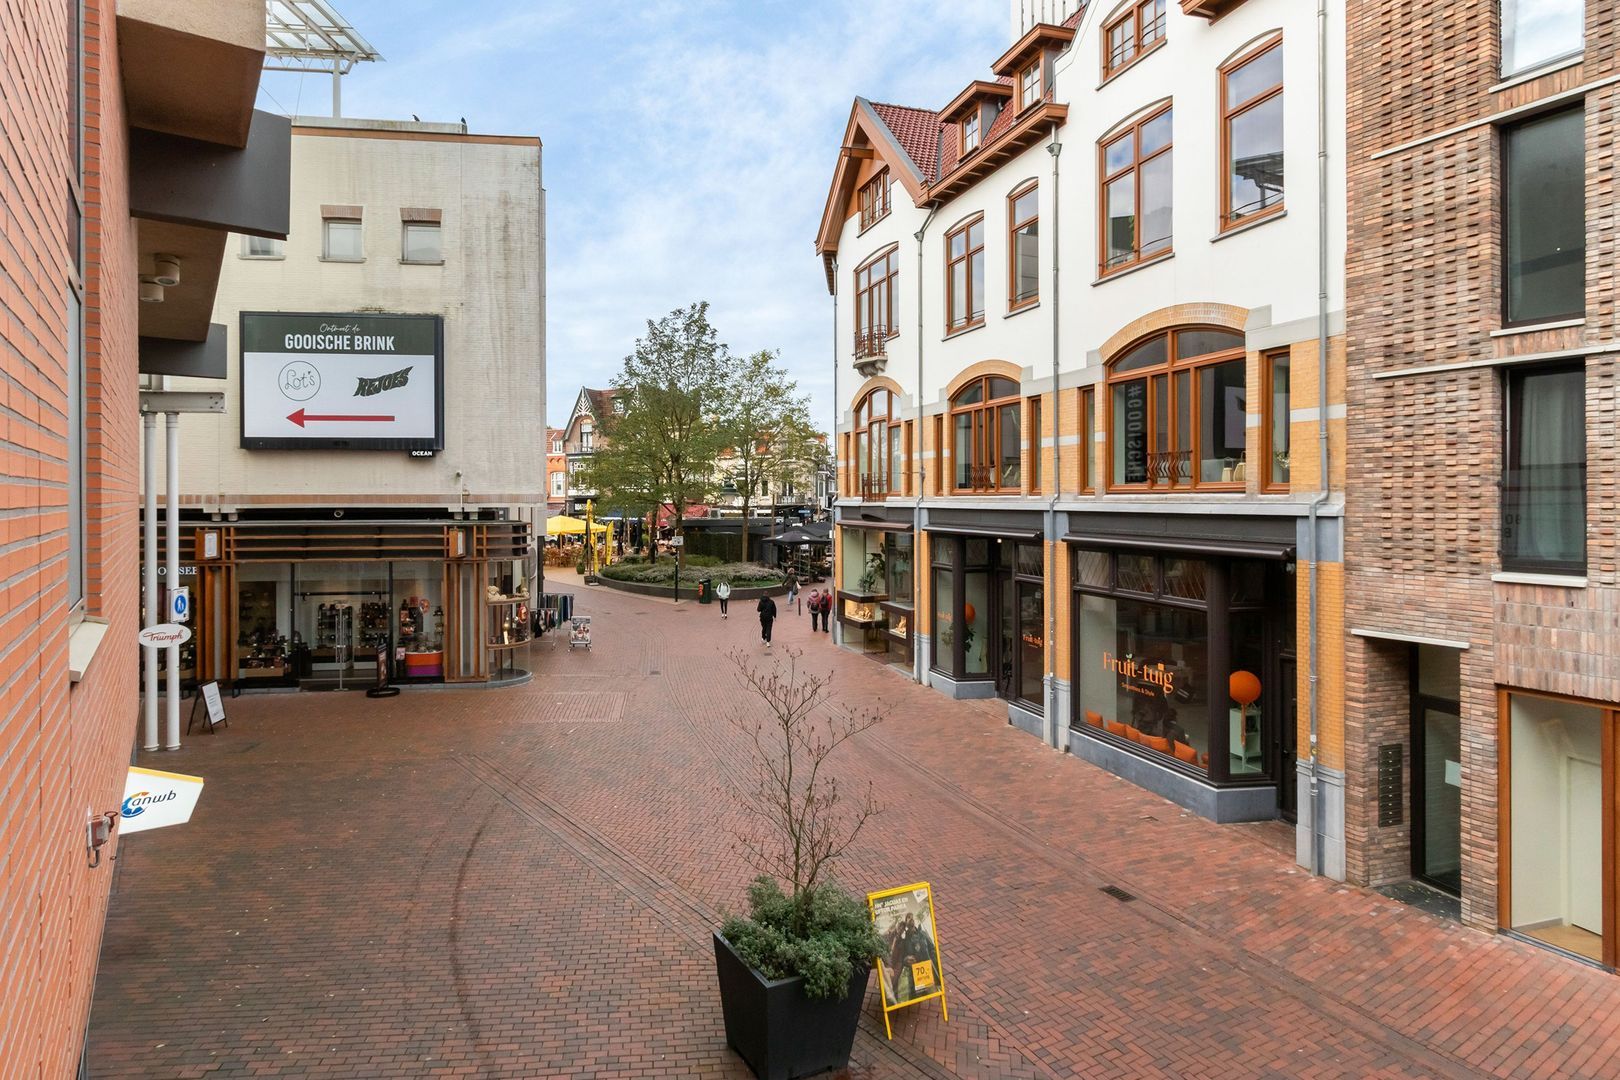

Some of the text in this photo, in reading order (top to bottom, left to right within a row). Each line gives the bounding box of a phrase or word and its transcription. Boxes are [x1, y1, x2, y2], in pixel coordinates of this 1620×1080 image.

[284, 334, 395, 350] GOOISCHE BRINK
[284, 369, 316, 391] Lot's
[143, 629, 184, 643] Triumph
[1103, 651, 1173, 693] Fruit-tuig
[131, 790, 177, 807] anwb
